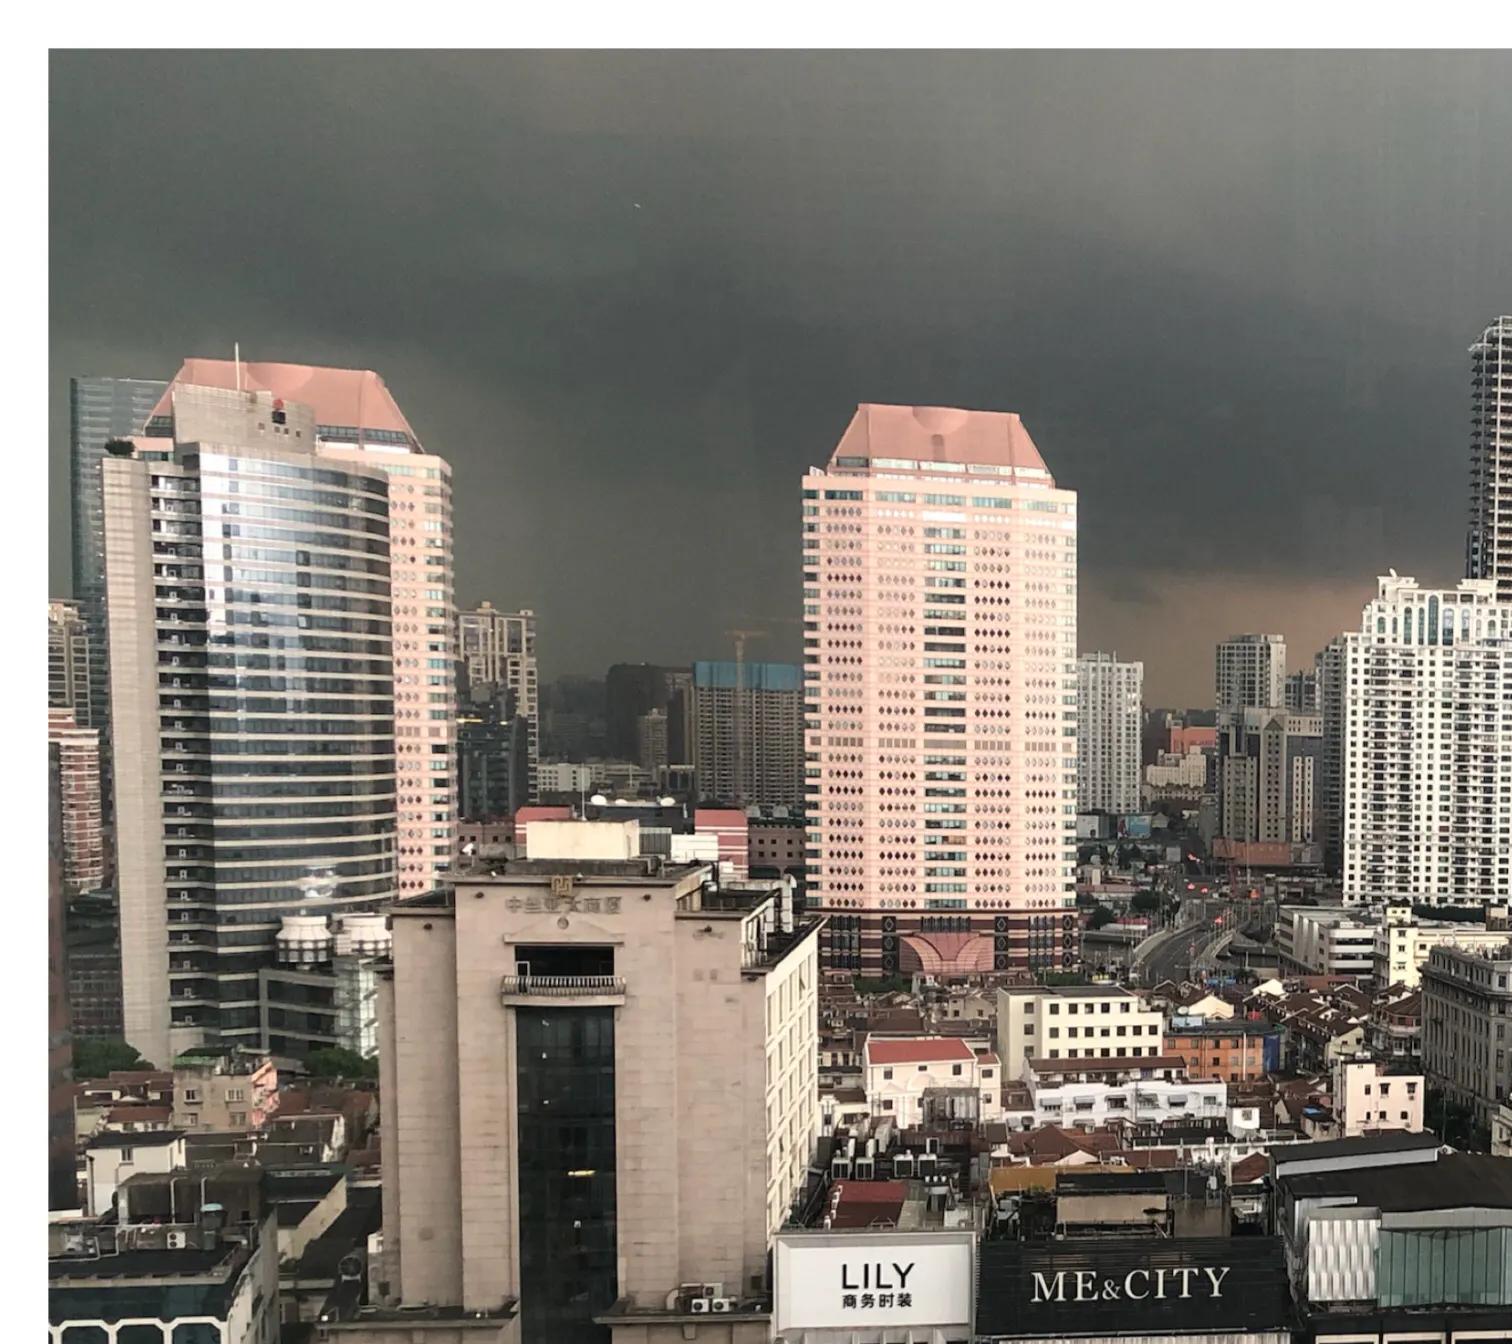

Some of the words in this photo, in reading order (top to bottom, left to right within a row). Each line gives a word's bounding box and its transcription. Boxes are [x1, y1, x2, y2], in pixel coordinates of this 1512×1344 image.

[842, 1263, 914, 1290] LILY
[1031, 1266, 1231, 1303] ME&CITY
[842, 1293, 913, 1309] 商务时装
